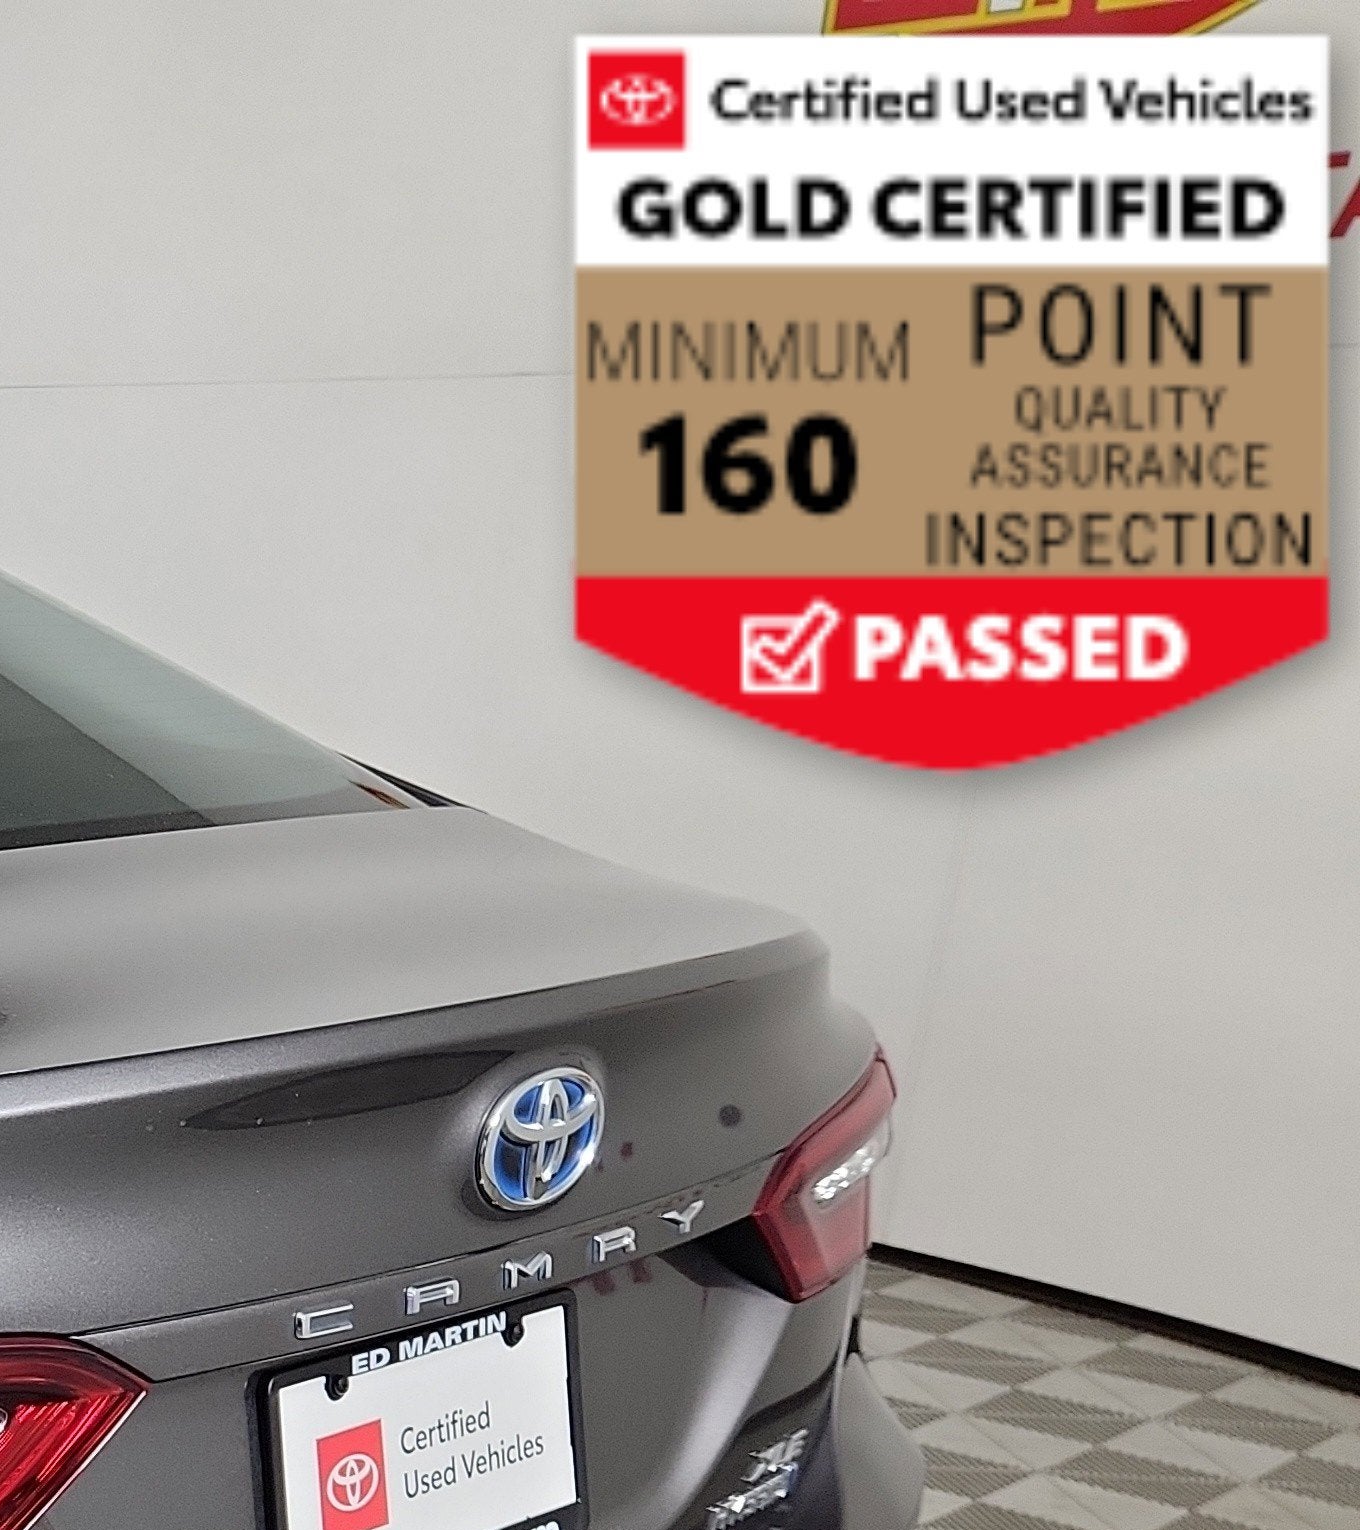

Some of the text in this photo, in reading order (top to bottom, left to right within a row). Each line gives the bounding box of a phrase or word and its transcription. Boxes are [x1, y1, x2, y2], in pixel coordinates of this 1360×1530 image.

[293, 1199, 705, 1339] CAMRY
[351, 1311, 508, 1375] ED MARTIN
[400, 1400, 491, 1454] Certified
[403, 1433, 545, 1498] Used Vehicles
